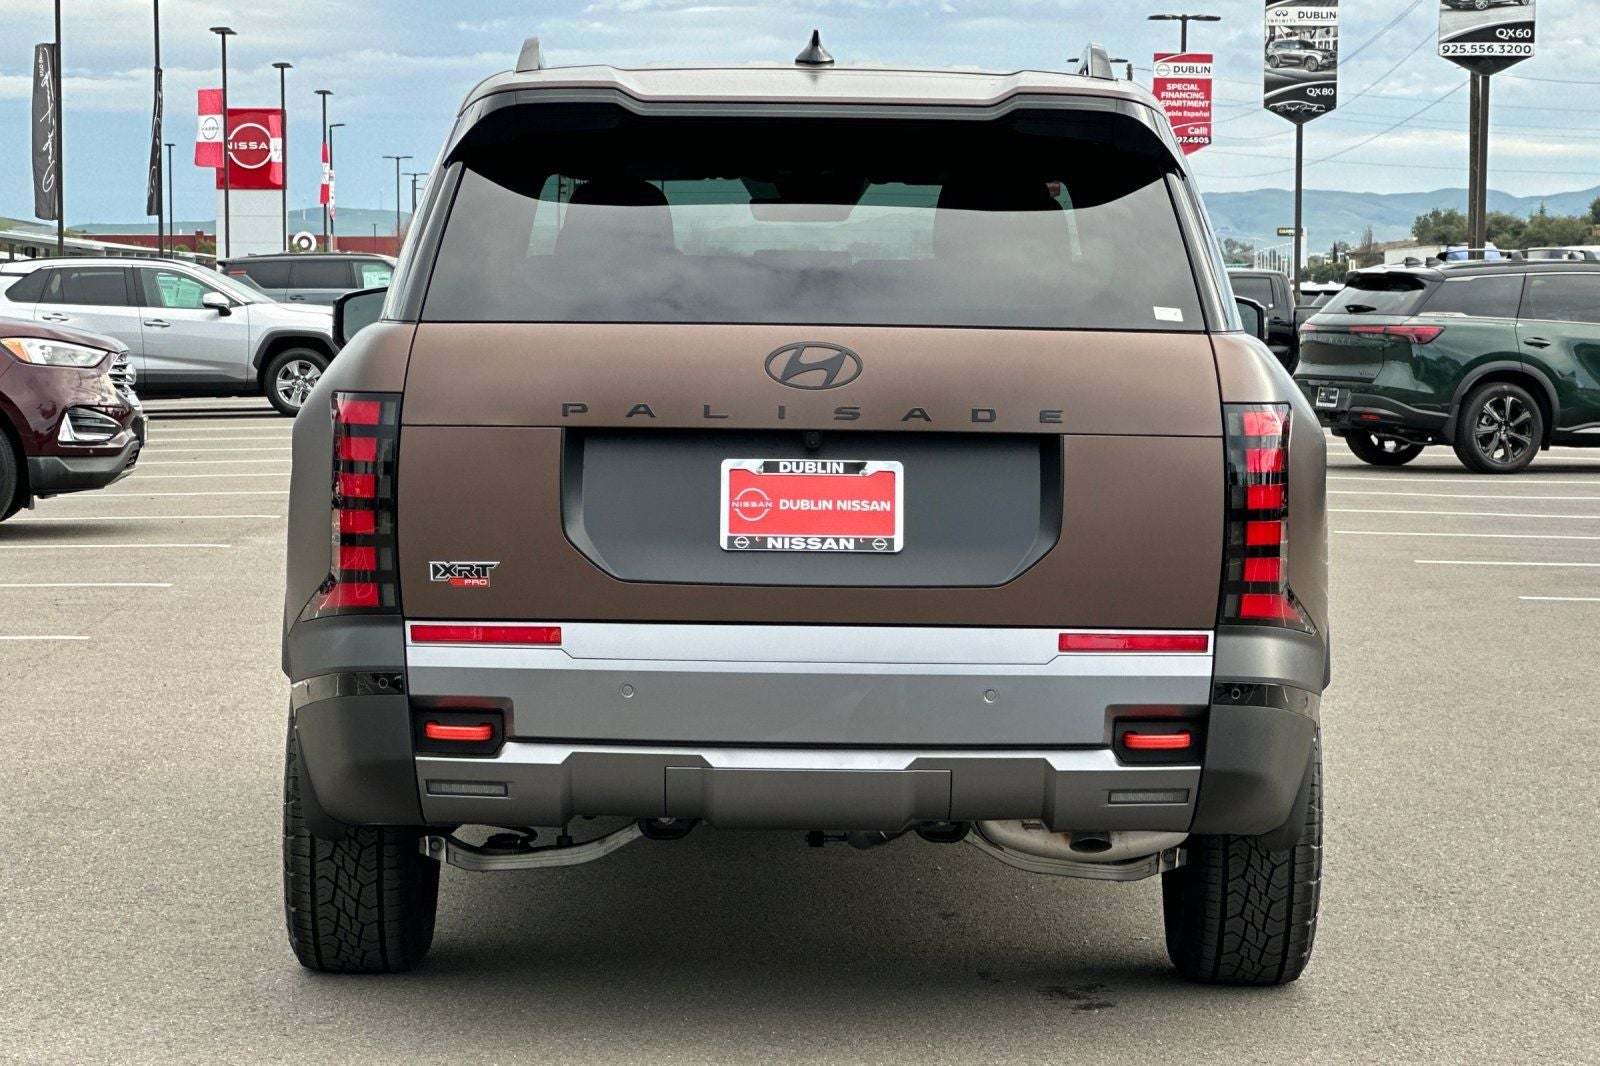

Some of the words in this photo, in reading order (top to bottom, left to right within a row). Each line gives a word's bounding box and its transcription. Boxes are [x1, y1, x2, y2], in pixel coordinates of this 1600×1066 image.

[1297, 11, 1337, 19] DUBLIN
[1495, 28, 1532, 40] QX60
[1442, 44, 1532, 54] 925.556.3200
[1173, 65, 1211, 74] DUBLIN
[1166, 83, 1200, 91] SPECIAL
[1306, 87, 1335, 97] QX80
[1160, 91, 1205, 100] FINANCING
[1160, 100, 1210, 108] EPARTMENT
[561, 403, 1064, 425] PALISADE
[778, 461, 844, 474] DUBLIN
[779, 499, 833, 511] DUBLIN
[836, 499, 891, 512] NISSAN
[766, 537, 855, 550] NISSAN
[431, 561, 500, 580] XRT
